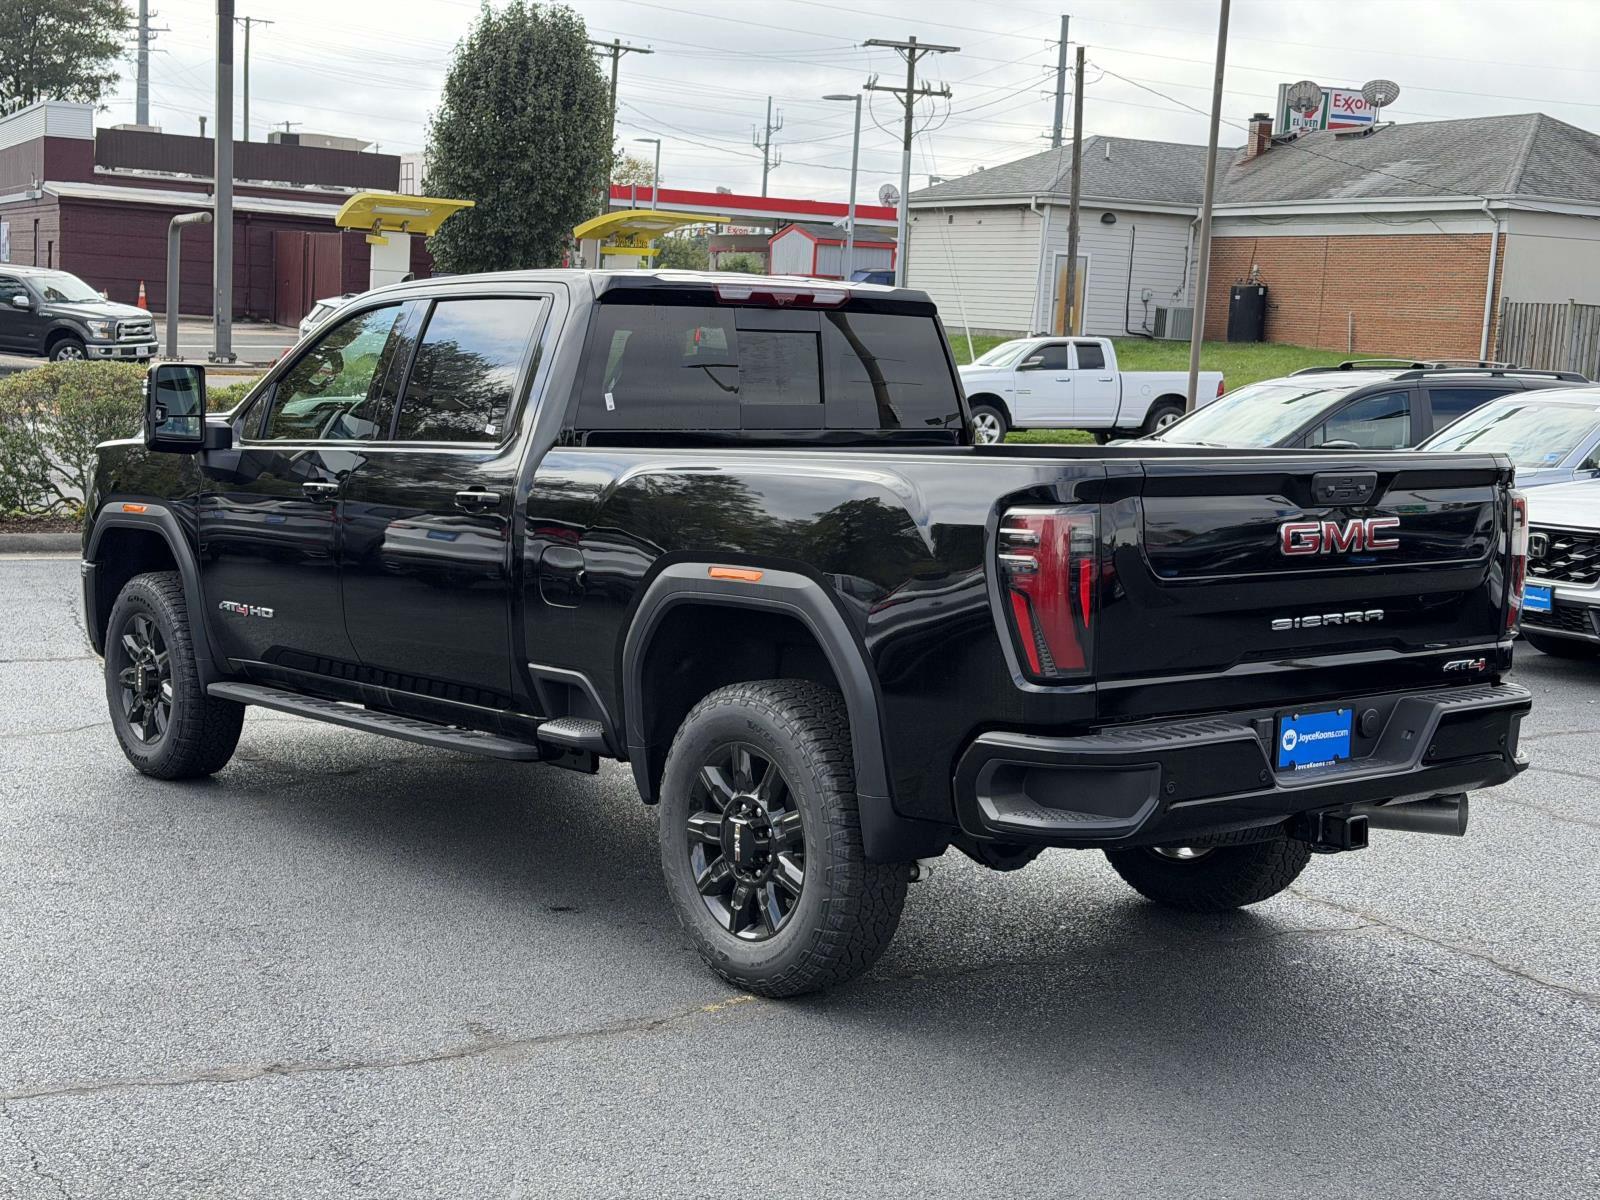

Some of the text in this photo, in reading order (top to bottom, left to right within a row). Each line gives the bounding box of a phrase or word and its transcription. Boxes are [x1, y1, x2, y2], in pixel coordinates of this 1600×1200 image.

[1280, 517, 1400, 555] GMC
[1271, 609, 1384, 630] SIERRA
[1298, 729, 1349, 743] JoyceKoons.com
